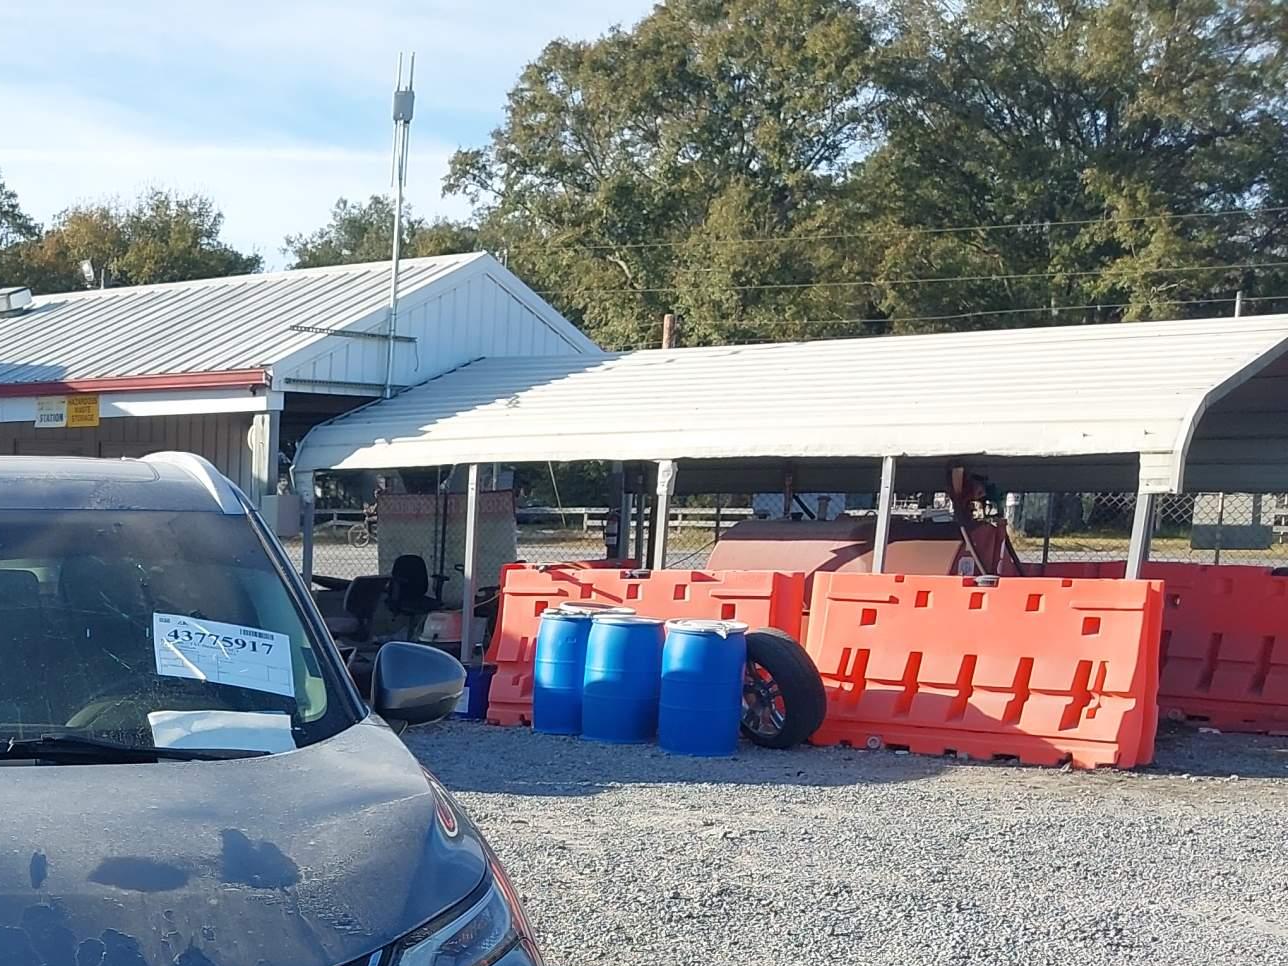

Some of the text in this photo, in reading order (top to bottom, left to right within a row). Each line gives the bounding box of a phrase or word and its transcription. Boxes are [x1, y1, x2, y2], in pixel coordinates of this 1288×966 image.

[68, 397, 98, 405] HAZARDO
[39, 413, 64, 423] STATION
[167, 629, 274, 655] 43775917
